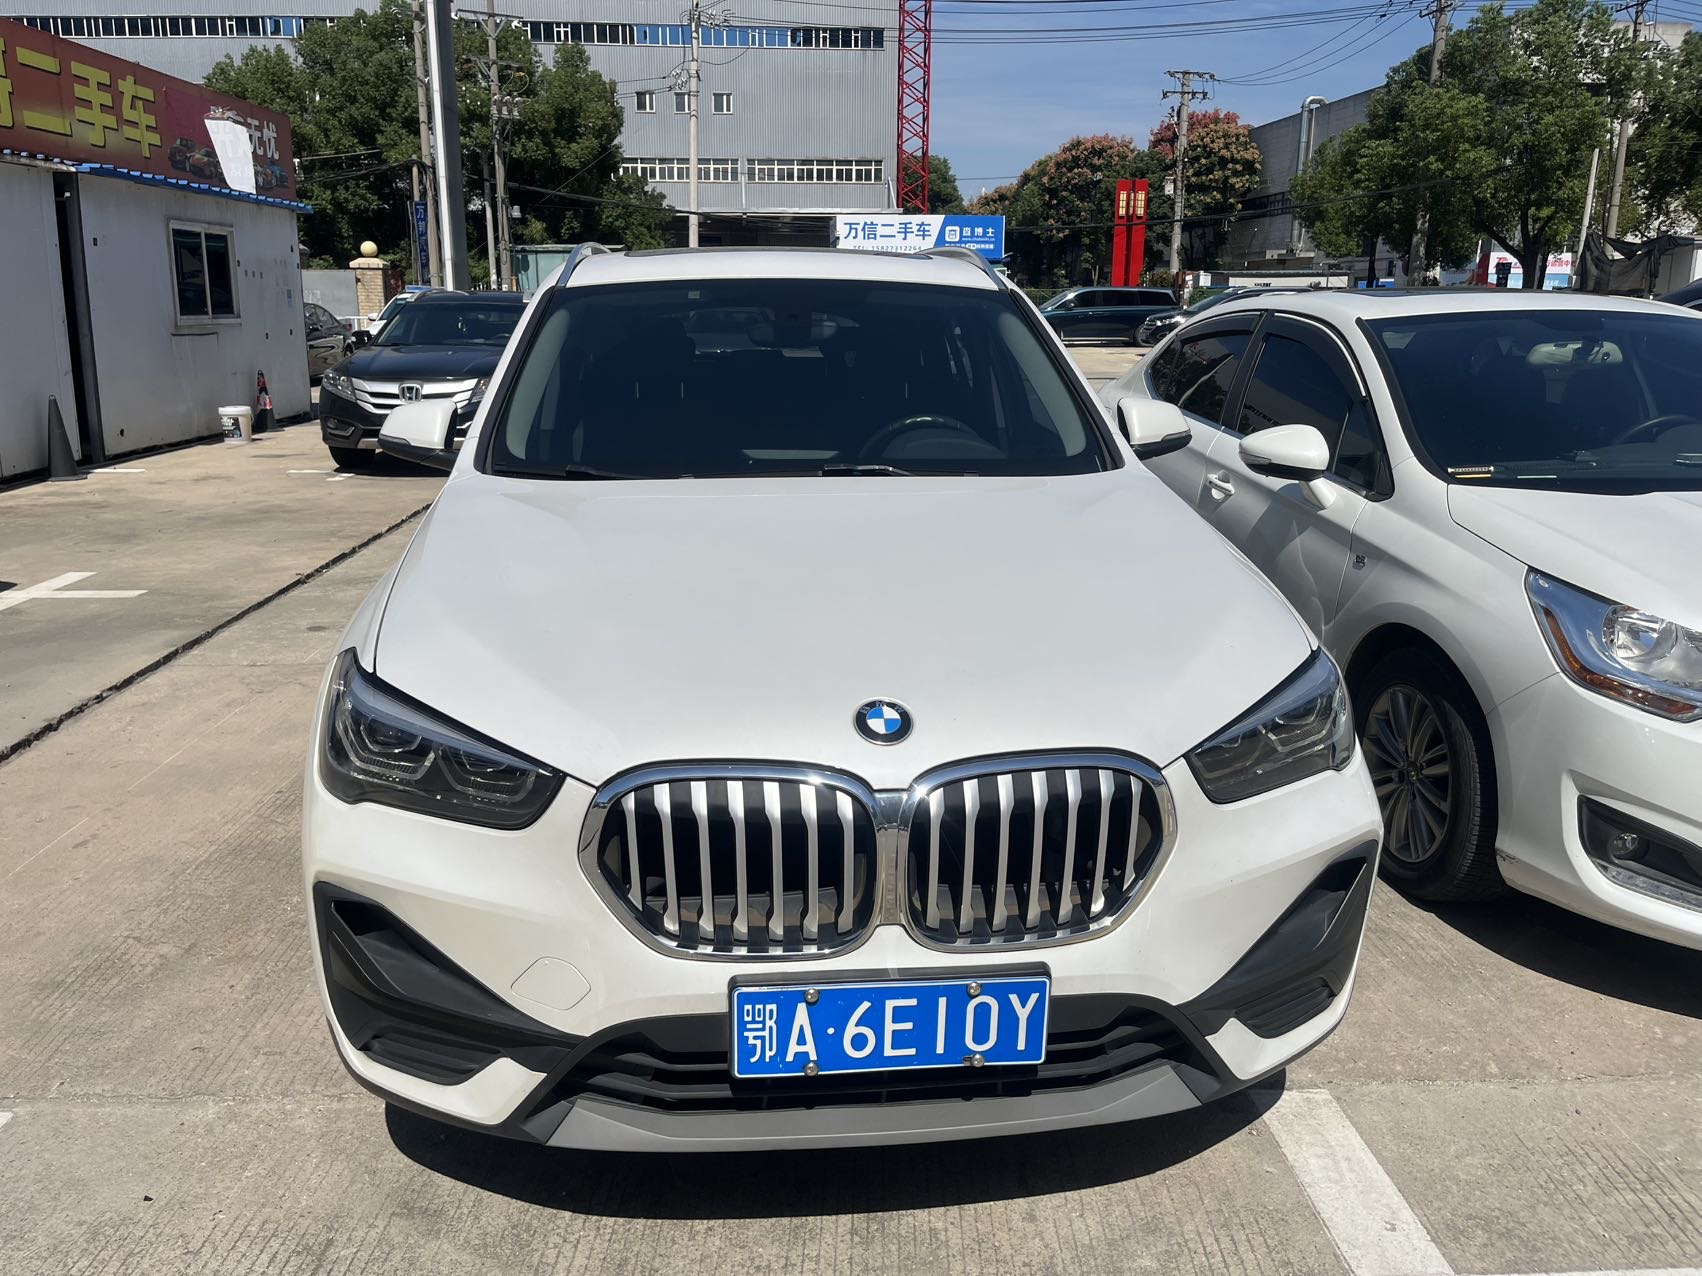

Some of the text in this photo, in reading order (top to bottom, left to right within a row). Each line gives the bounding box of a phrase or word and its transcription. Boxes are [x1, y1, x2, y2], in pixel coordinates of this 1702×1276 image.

[0, 37, 162, 158] 二手车
[843, 221, 932, 241] 万信二手车
